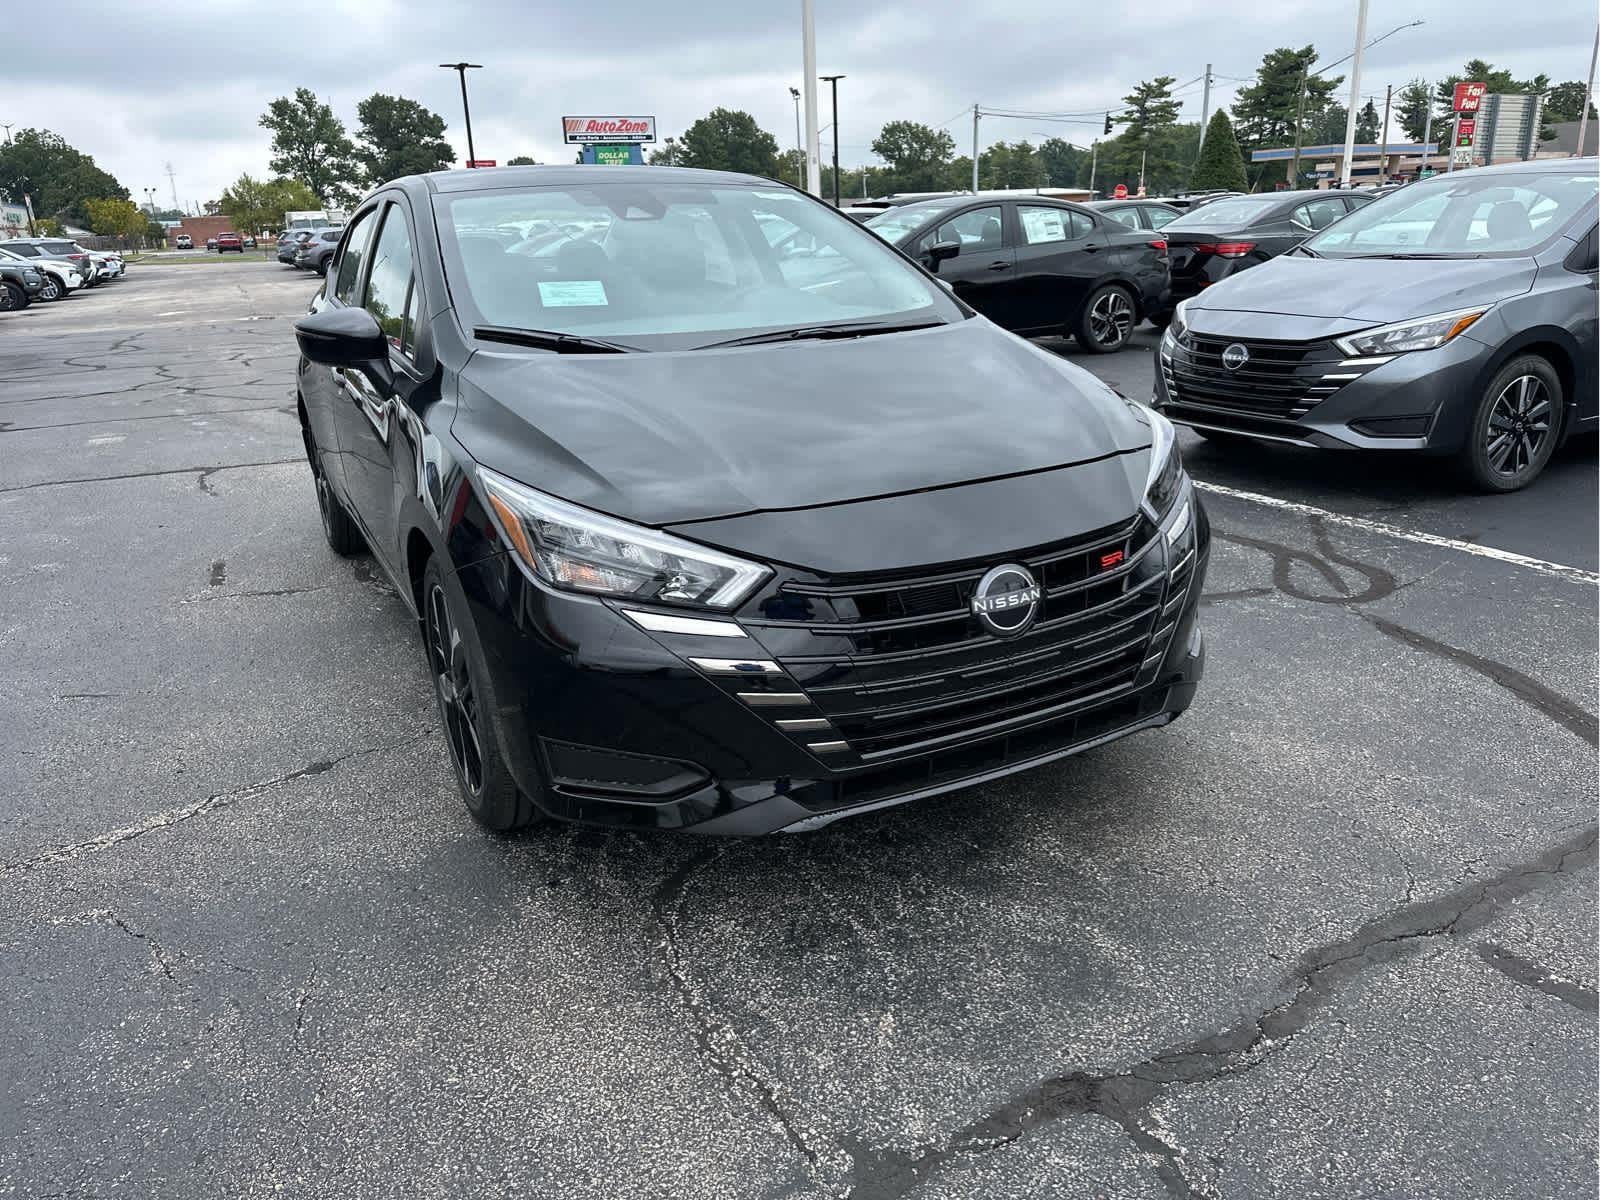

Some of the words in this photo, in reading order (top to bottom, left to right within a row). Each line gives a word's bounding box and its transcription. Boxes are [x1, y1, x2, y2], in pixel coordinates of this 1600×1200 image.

[1467, 84, 1484, 96] Fast
[1461, 98, 1479, 109] Fuel
[586, 119, 649, 132] AutoZone
[1101, 551, 1123, 567] SR
[974, 588, 1041, 611] NISSAN
